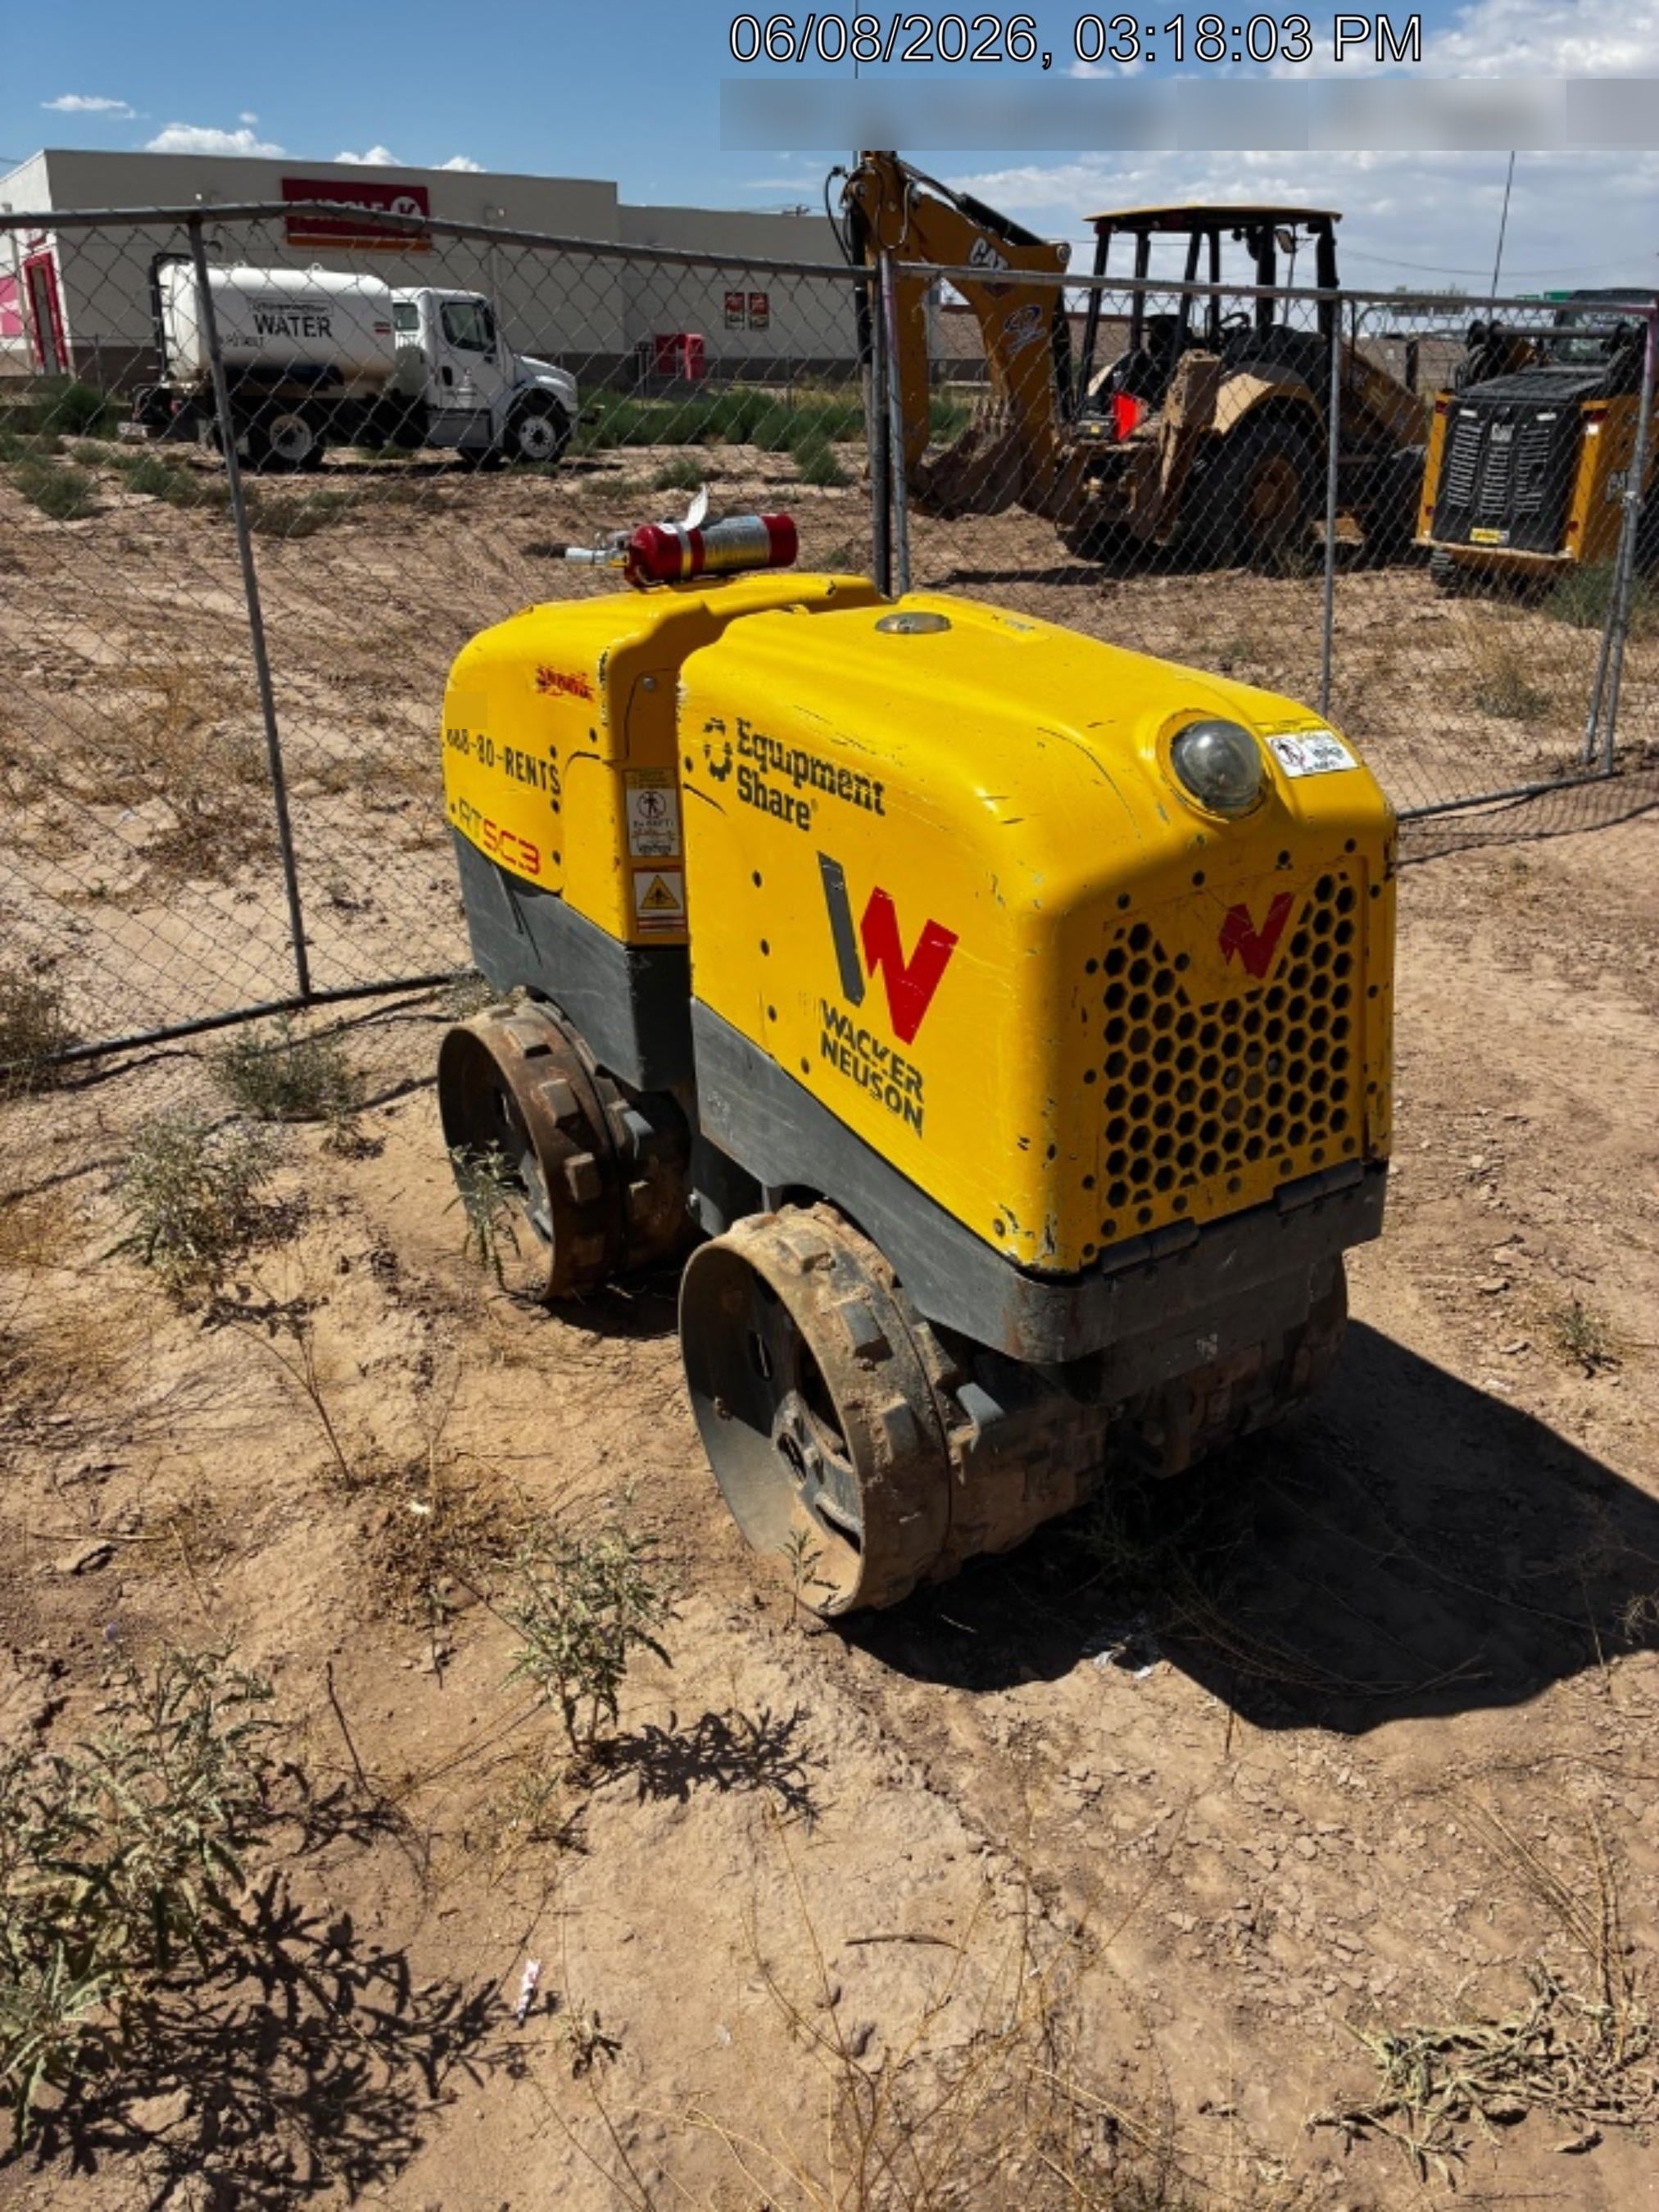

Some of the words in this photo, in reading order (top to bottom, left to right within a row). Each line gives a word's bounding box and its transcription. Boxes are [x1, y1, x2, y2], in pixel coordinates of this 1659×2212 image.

[252, 314, 333, 338] WATER
[737, 716, 886, 817] Equipment
[821, 997, 924, 1105] WACKER
[821, 1030, 923, 1141] NEUSON
